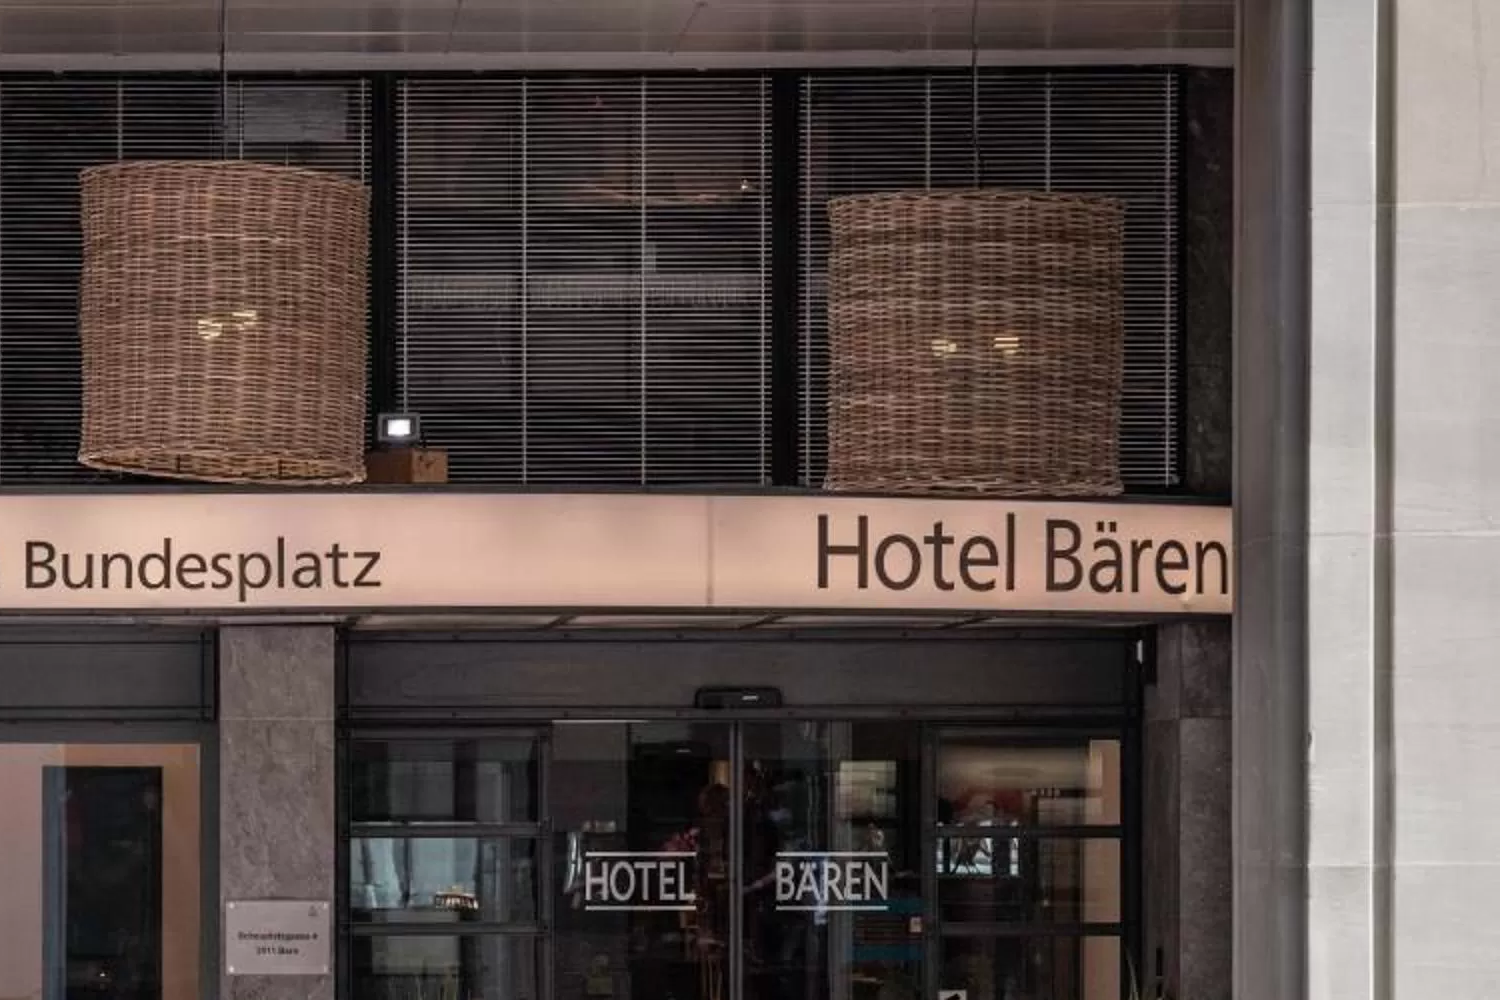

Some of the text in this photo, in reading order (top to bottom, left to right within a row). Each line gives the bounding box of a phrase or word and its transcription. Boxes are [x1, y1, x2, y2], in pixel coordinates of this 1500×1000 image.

[25, 536, 382, 602] Bundesplatz
[817, 511, 1228, 596] Hotel Bären
[585, 861, 887, 901] HOTEL BÄREN
